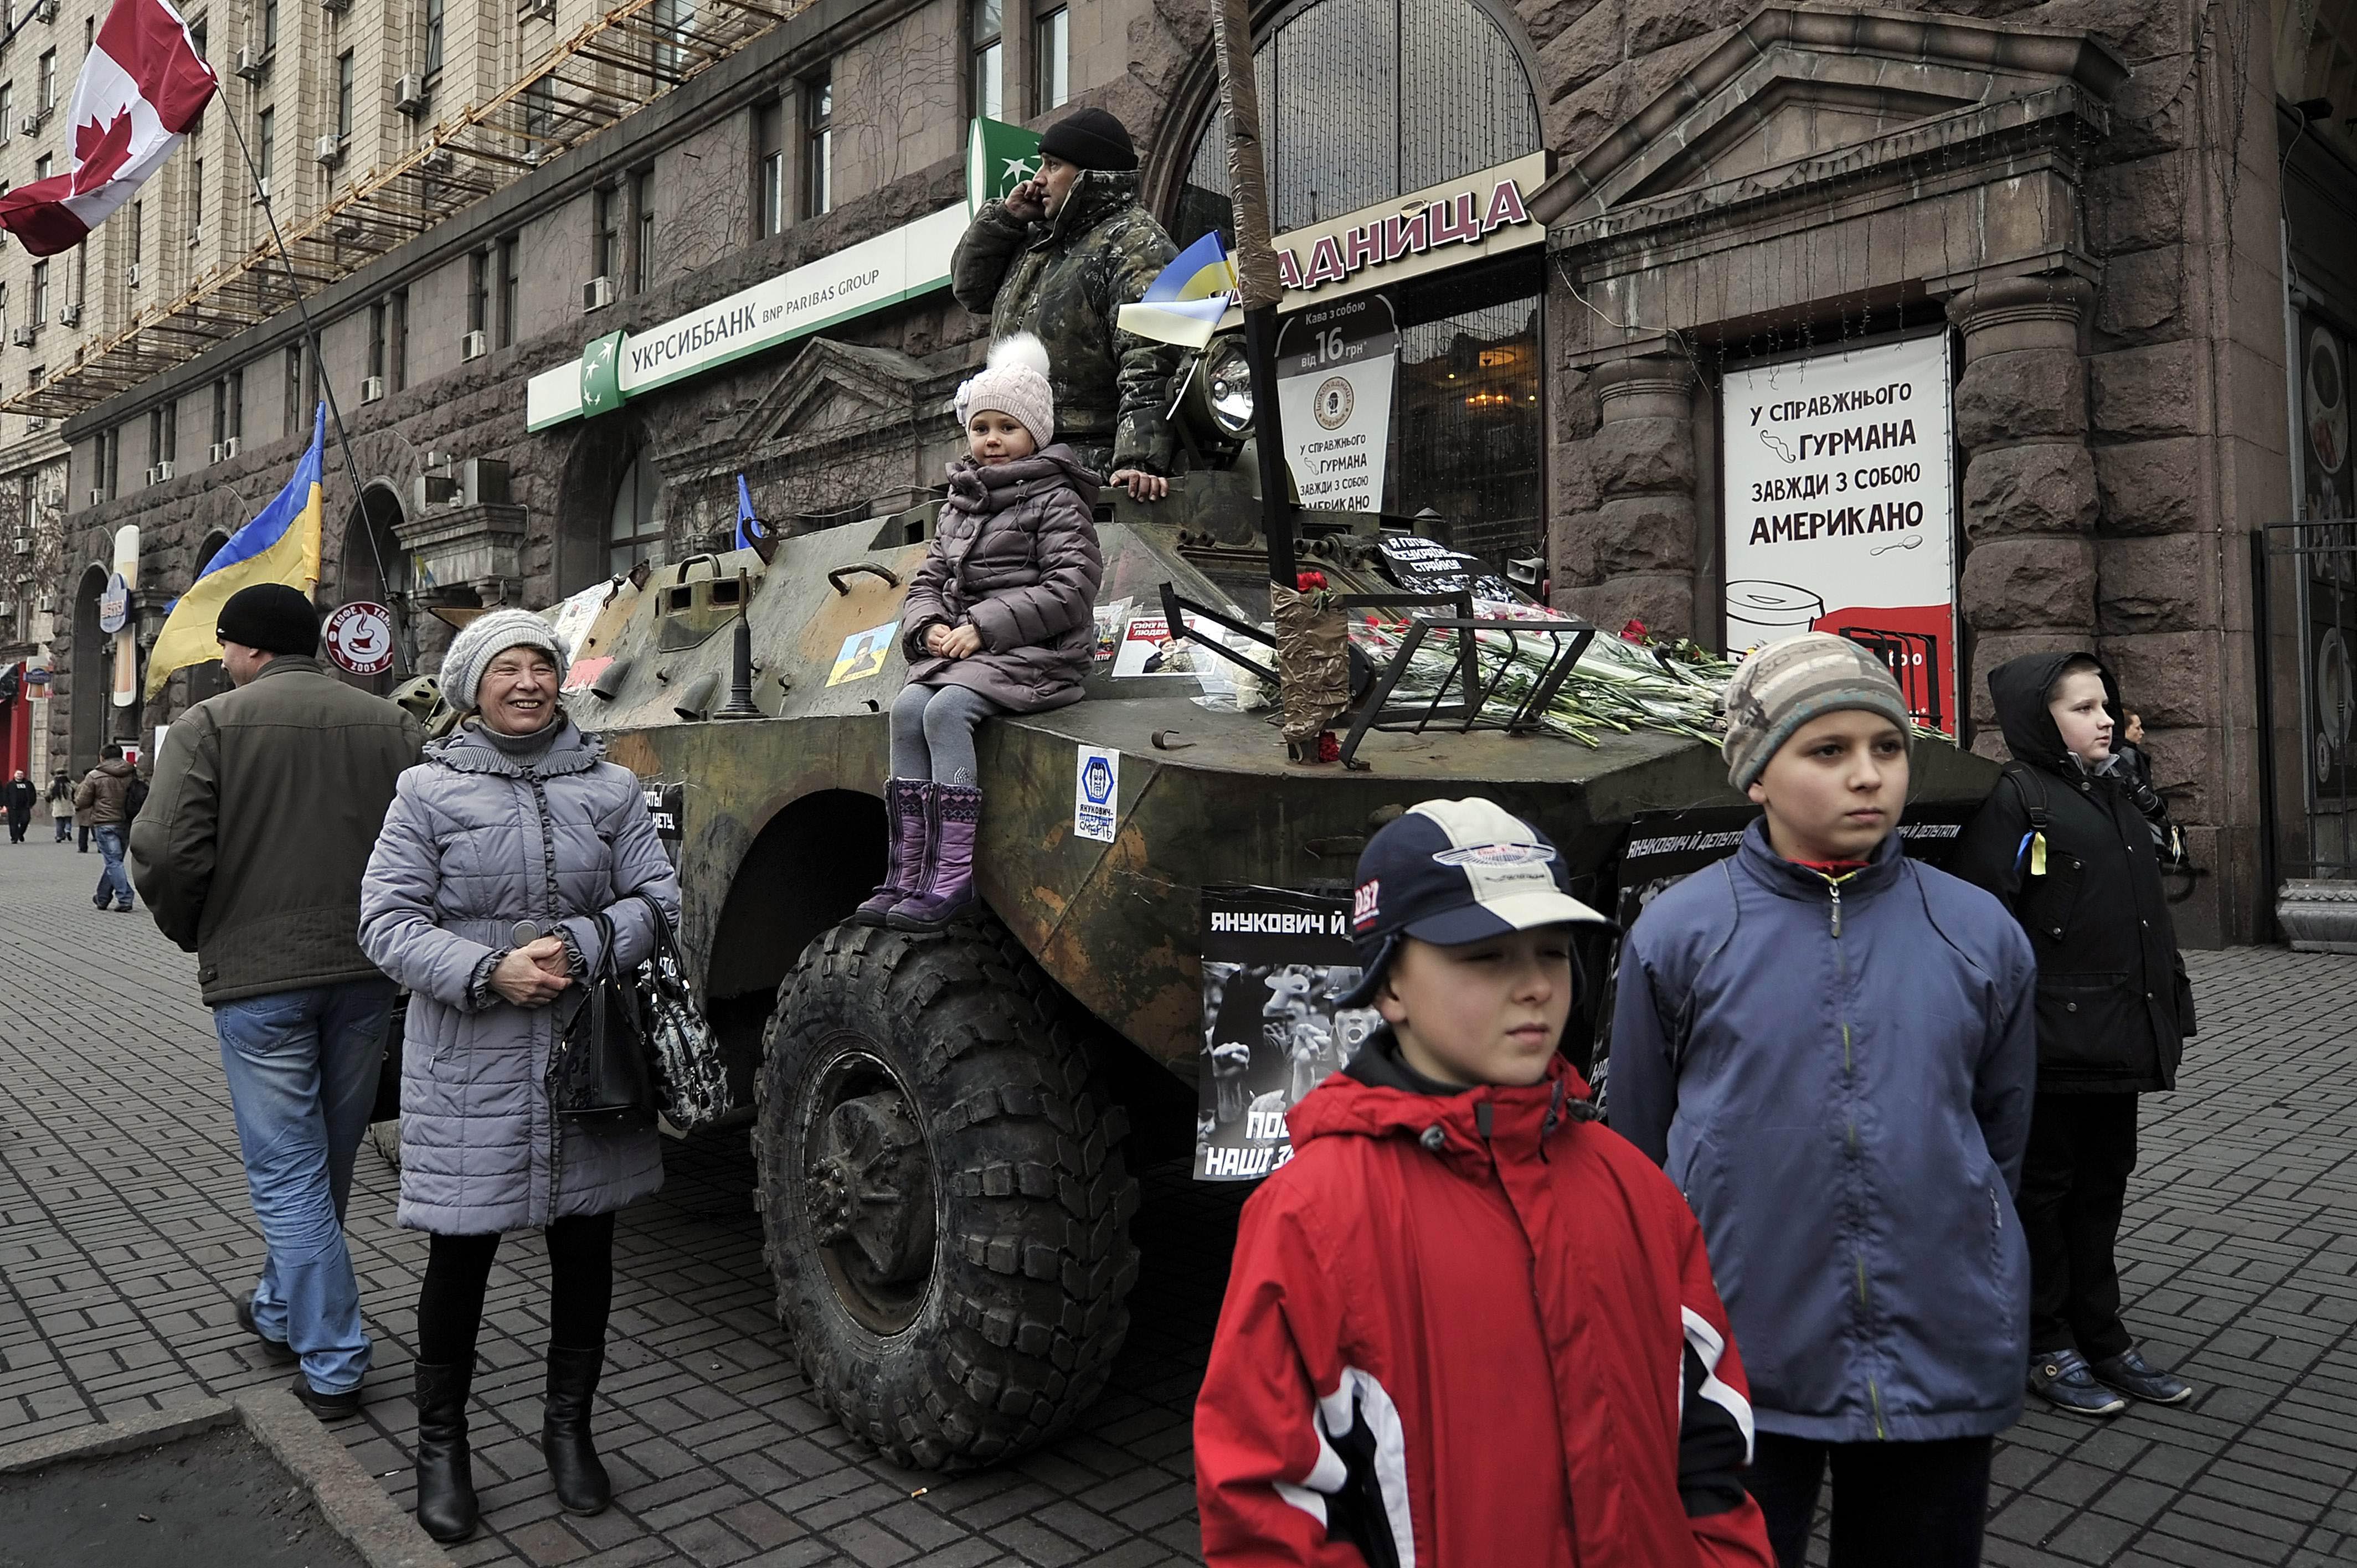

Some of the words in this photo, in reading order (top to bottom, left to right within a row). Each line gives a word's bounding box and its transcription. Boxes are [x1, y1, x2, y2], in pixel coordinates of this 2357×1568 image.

[1231, 179, 1529, 306] АДНИЦА
[763, 305, 784, 323] BNP
[786, 286, 835, 314] PARIBAS
[838, 269, 879, 295] GROUP
[1305, 312, 1327, 326] Кава
[1336, 301, 1366, 316] собою
[631, 302, 756, 373] УКРСИББАНК
[1301, 354, 1316, 368] від
[1315, 326, 1345, 364] 16
[1749, 406, 1762, 427] У
[1769, 382, 1912, 423] СПРАВЖНЬОГО
[1300, 445, 1305, 456] У
[1308, 434, 1366, 454] СПРАВЖНЬОГО
[1799, 419, 1916, 461] ГУРМАНА
[1320, 452, 1367, 474] ГУРМАНА
[1300, 481, 1332, 496] ЗАВЖДИ
[1342, 474, 1369, 490] СОБОЮ
[1752, 473, 1829, 503] ЗАВЖДИ
[1836, 472, 1847, 493] З
[1854, 462, 1921, 490] СОБОЮ
[1303, 494, 1370, 511] МЕРИКАНО
[1749, 500, 1924, 546] АМЕРИКАНО
[1388, 538, 1401, 549] Я
[1410, 558, 1463, 572] СТРАЙКУ!
[332, 606, 358, 628] КОФЕ
[351, 662, 377, 673] 2005
[1913, 824, 1962, 839] ДЕПУТАТИ
[1627, 835, 1689, 859] ЯНУКОВИЧ
[1354, 878, 1380, 916] DB7
[1211, 912, 1325, 935] ЯНУКОВИЧ
[1331, 910, 1346, 935] Й
[1205, 1147, 1274, 1176] НАШІ
